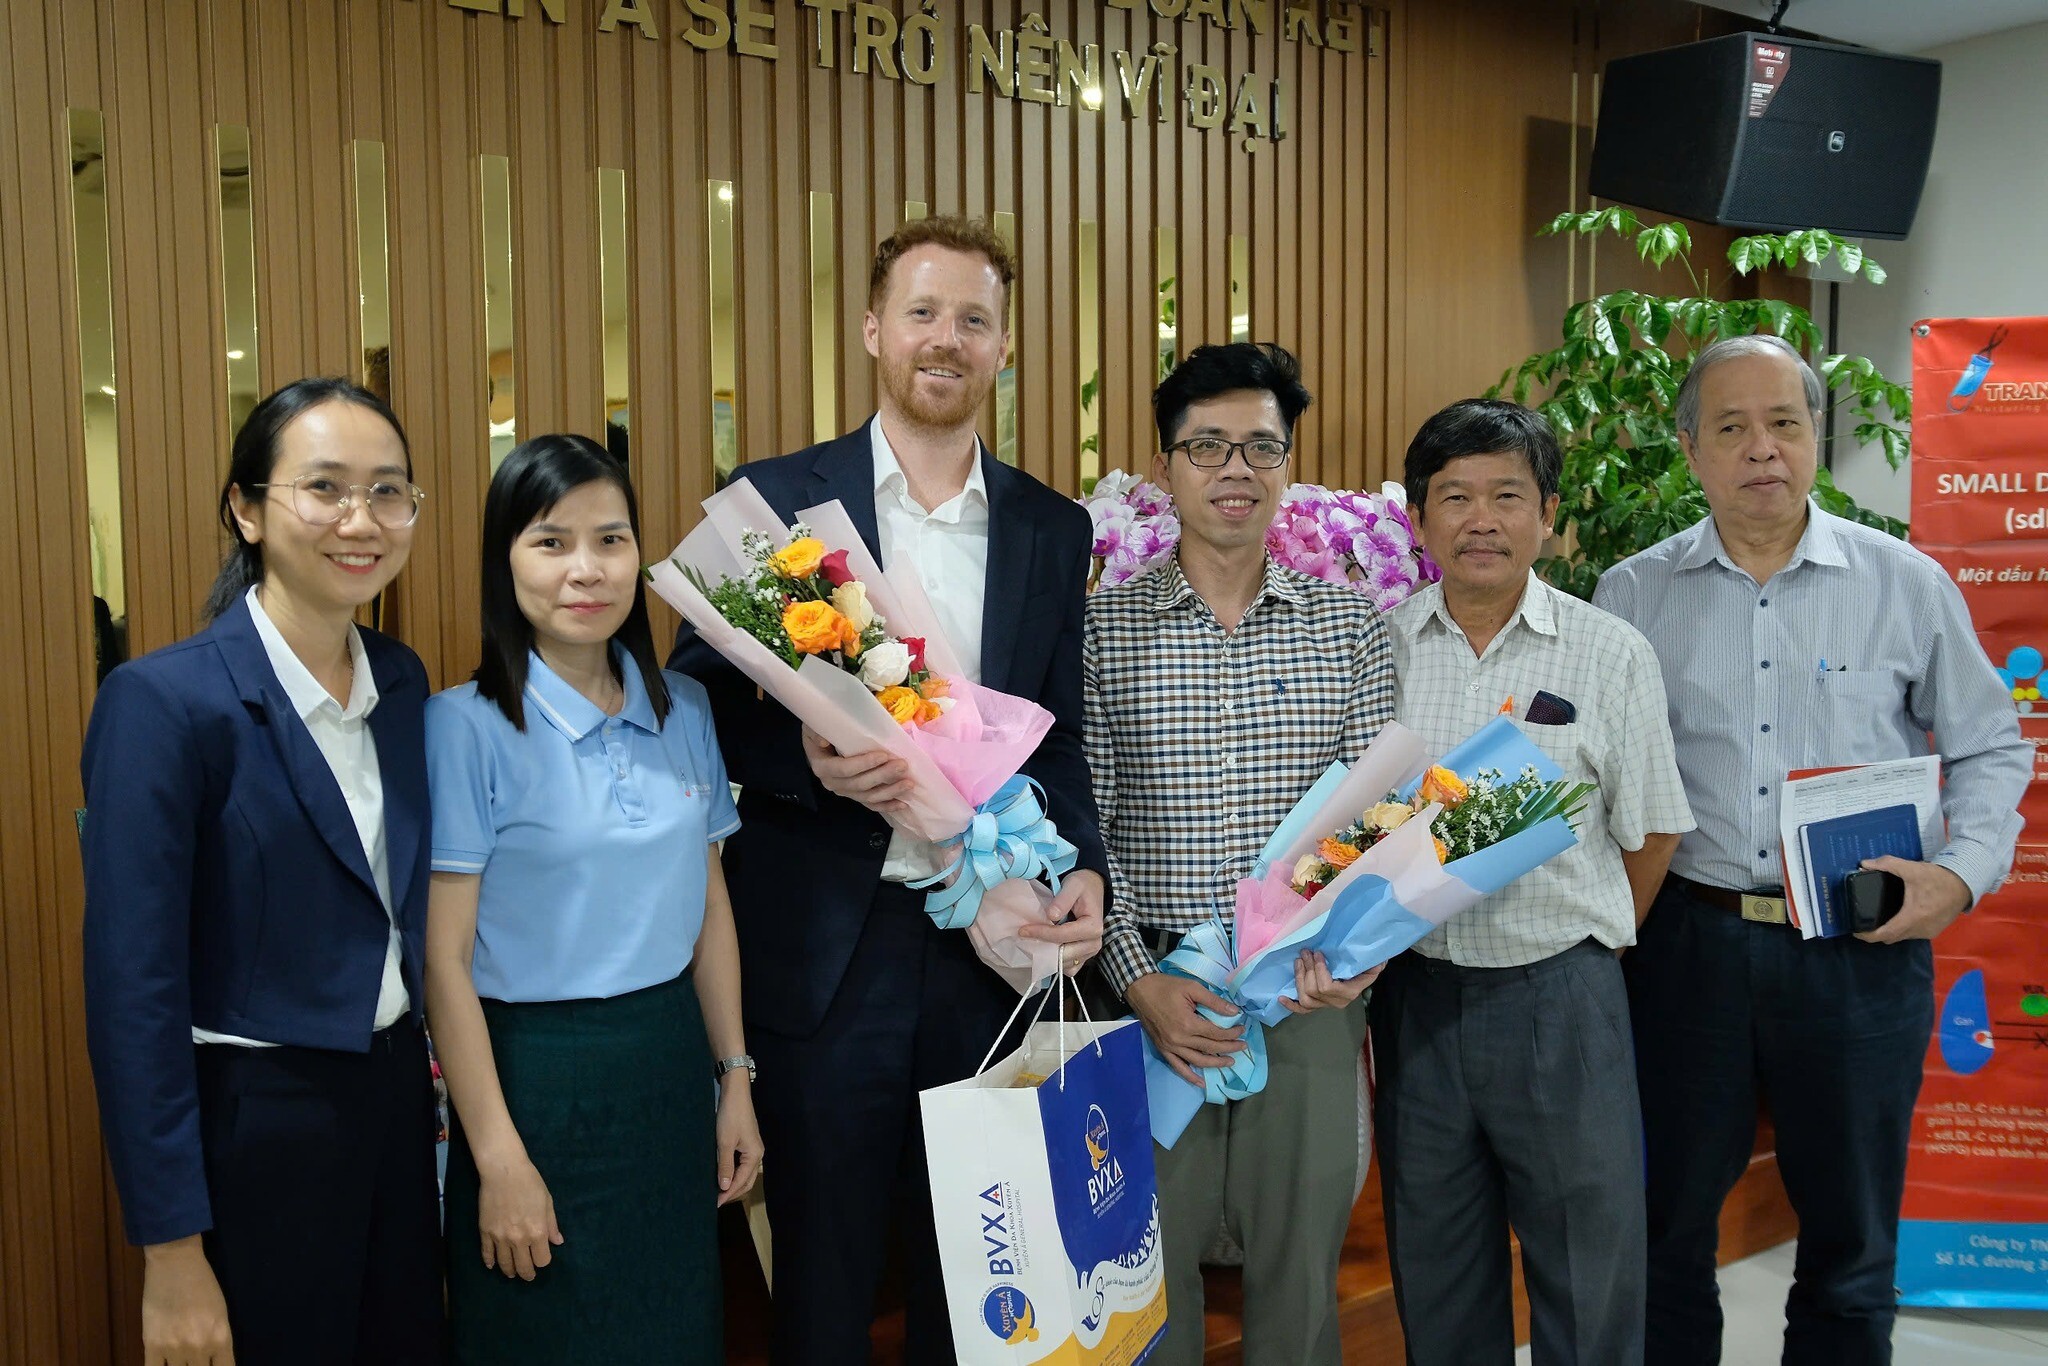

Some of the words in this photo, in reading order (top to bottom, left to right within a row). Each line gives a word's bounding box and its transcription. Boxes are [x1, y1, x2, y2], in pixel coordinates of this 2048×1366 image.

[968, 13, 1101, 111] NÊN
[1184, 63, 1287, 153] ĐẠI
[1937, 472, 2028, 494] SMALL
[1957, 567, 1994, 585] Một
[1997, 564, 2033, 582] dấu
[1087, 1156, 1123, 1206] BVXA
[979, 1181, 1014, 1275] BVXA
